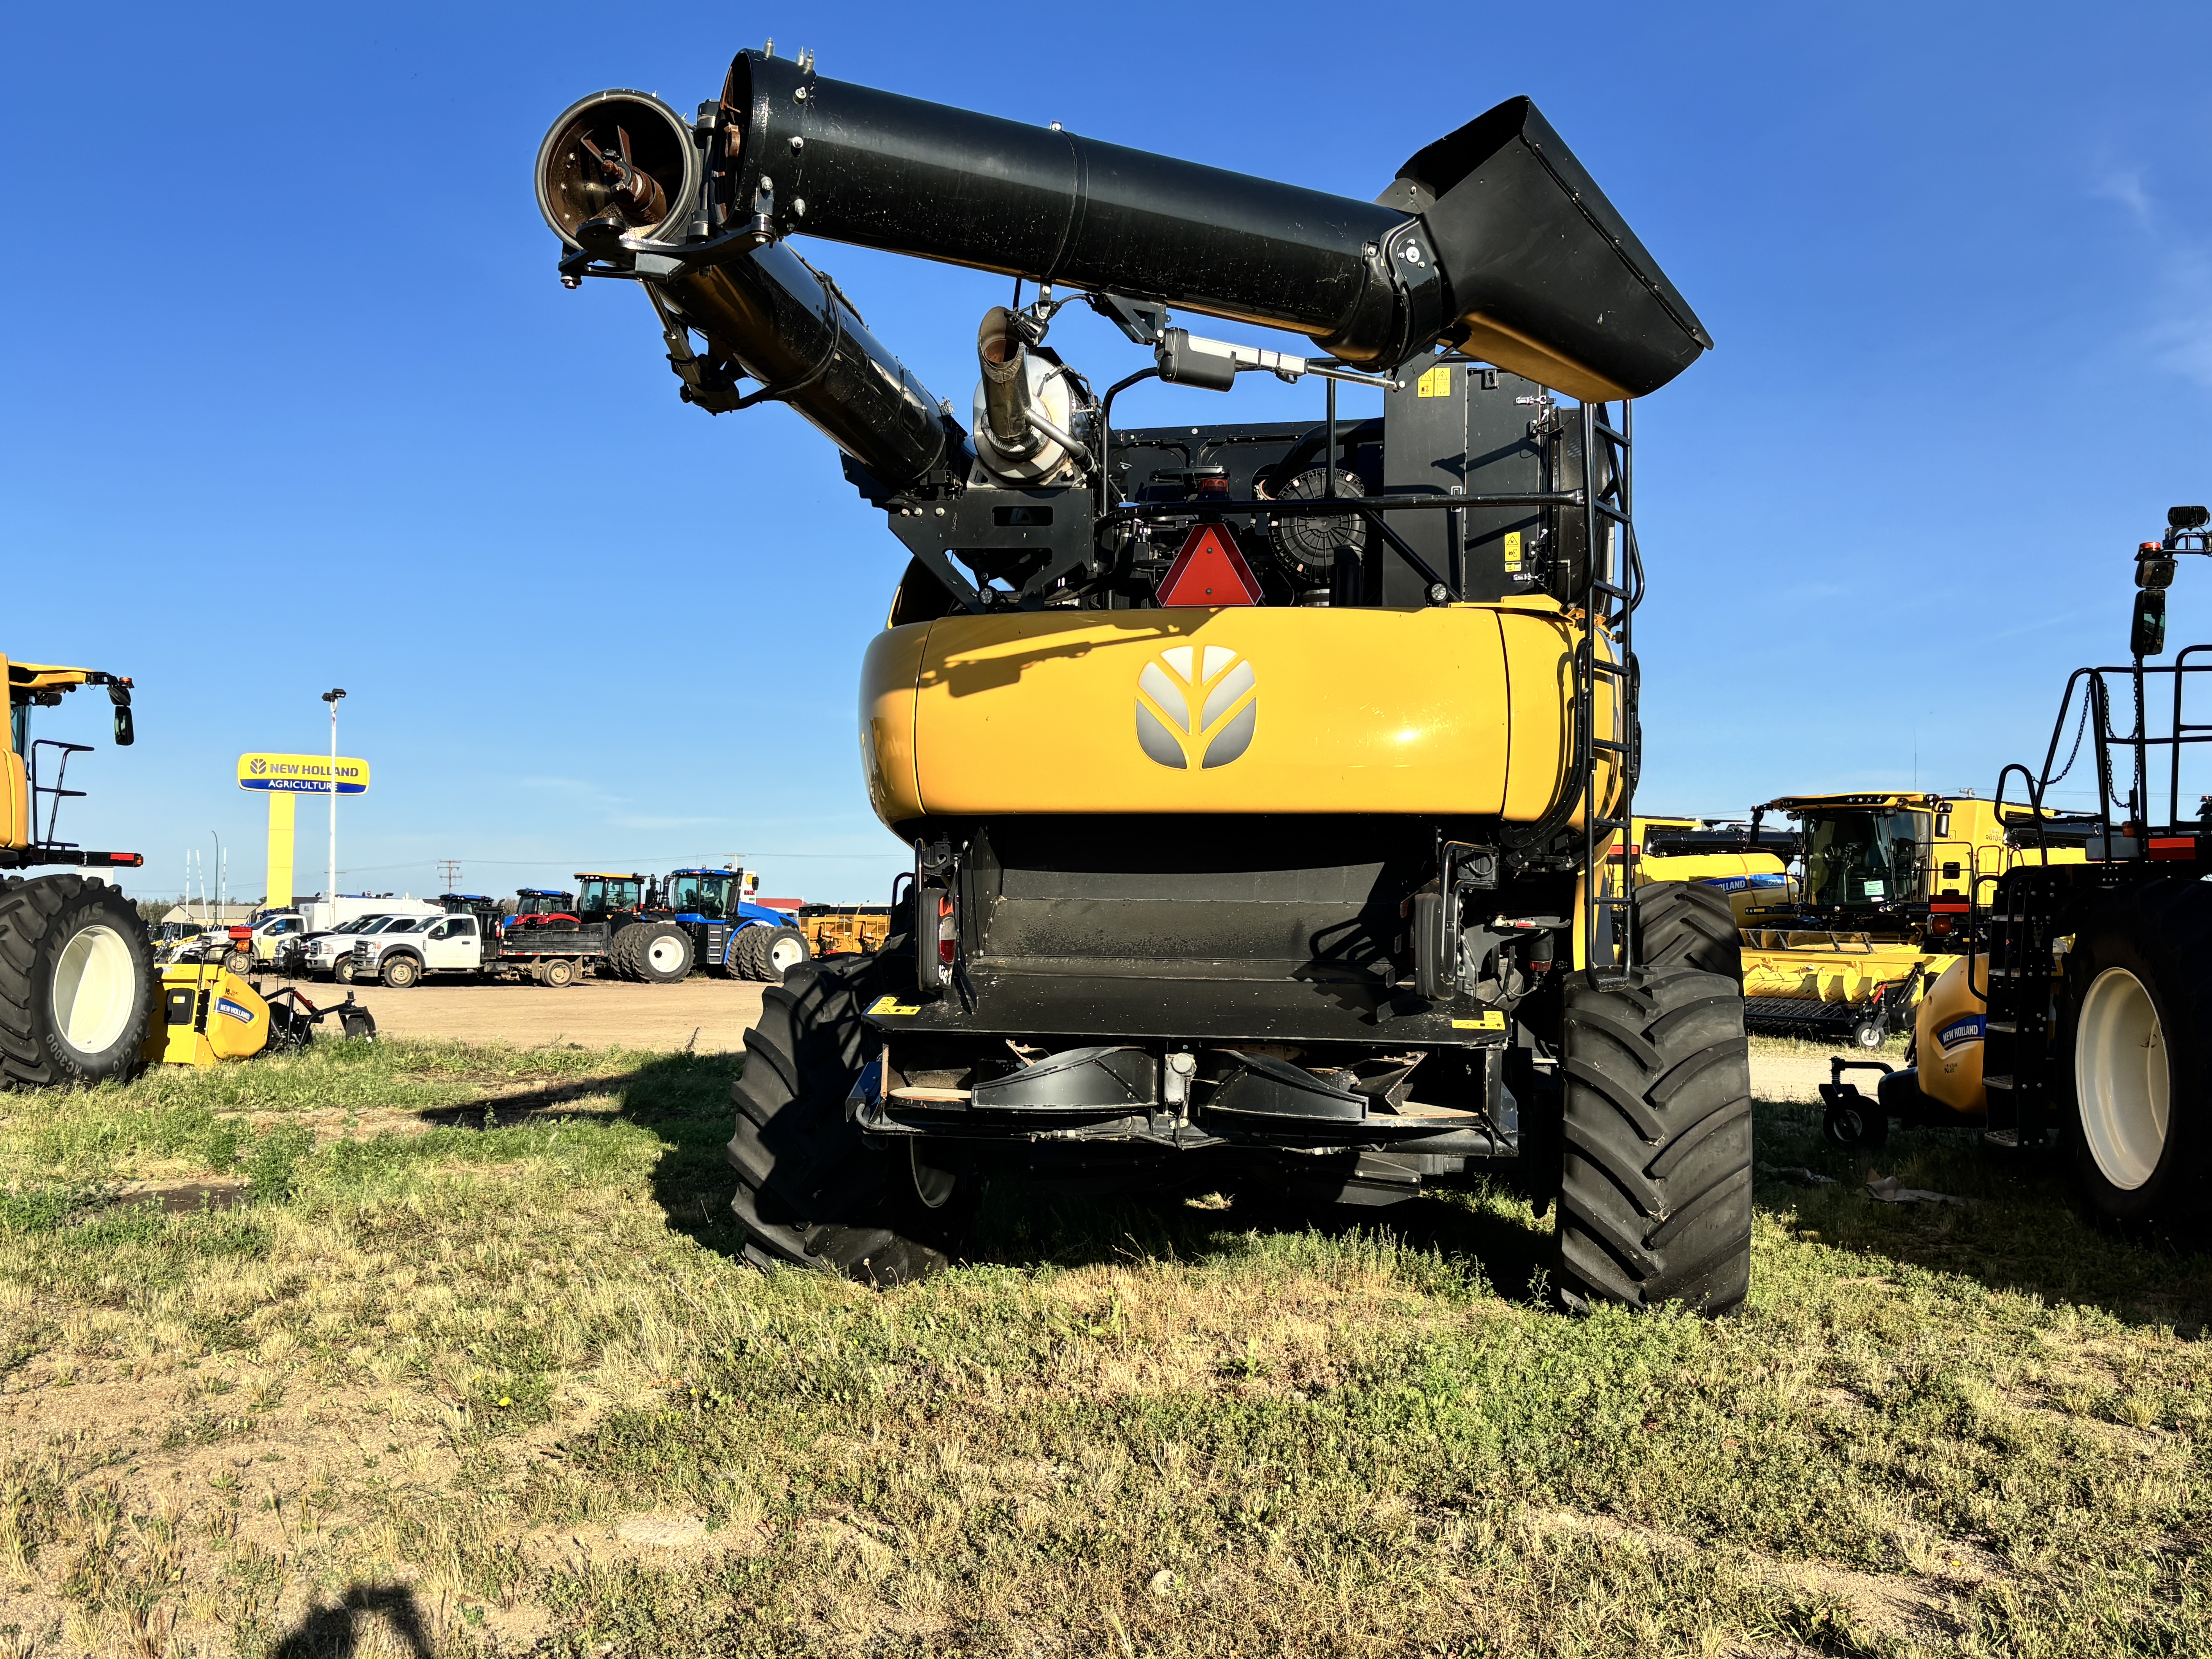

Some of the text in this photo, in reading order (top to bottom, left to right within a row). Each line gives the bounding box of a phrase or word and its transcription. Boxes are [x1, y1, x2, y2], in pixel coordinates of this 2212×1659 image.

[270, 764, 359, 777] NEW HOLLAND
[1712, 880, 1745, 891] LLAND
[220, 1004, 250, 1020] NEW HOLLAND
[1943, 1025, 1978, 1043] NEW HOLLAND
